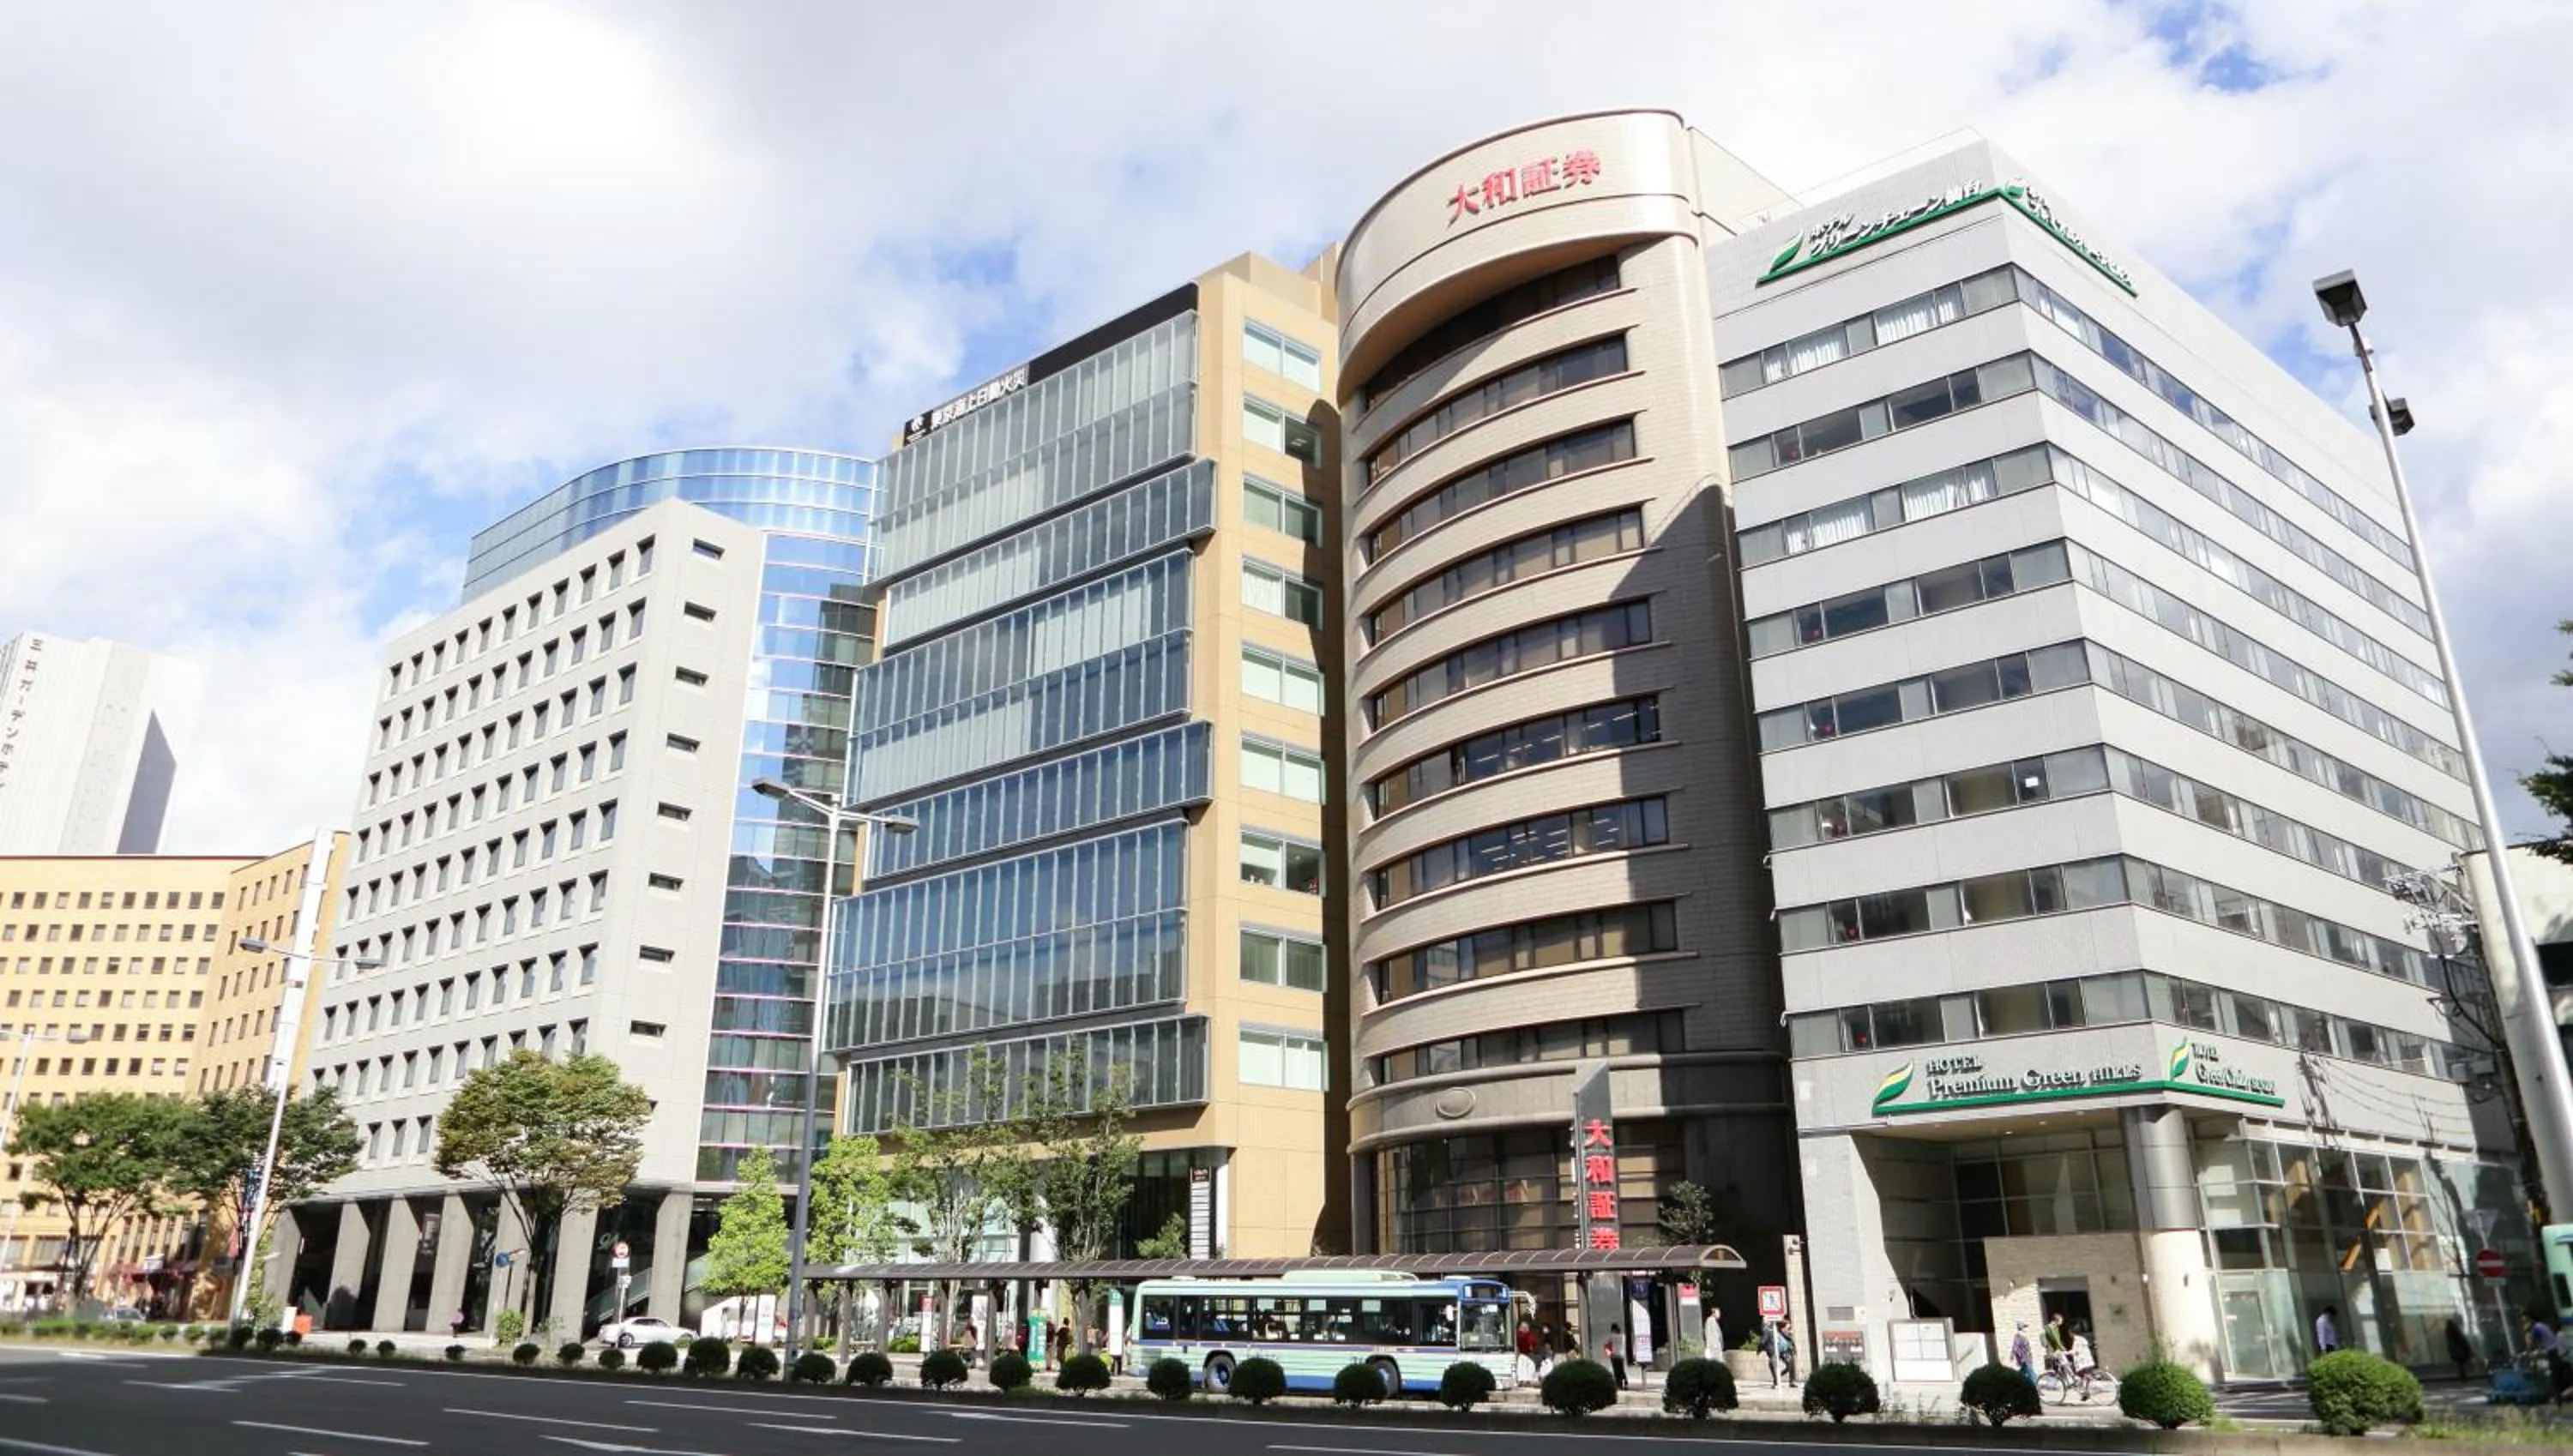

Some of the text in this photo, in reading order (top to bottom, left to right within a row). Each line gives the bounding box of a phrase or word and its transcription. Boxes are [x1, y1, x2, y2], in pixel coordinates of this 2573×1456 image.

[1446, 149, 1601, 232] 大和証券
[1926, 1056, 1982, 1075] HOTEL
[1928, 1074, 2017, 1098] Premium
[2021, 1068, 2085, 1091] Green
[1584, 1118, 1620, 1253] 大和証券
